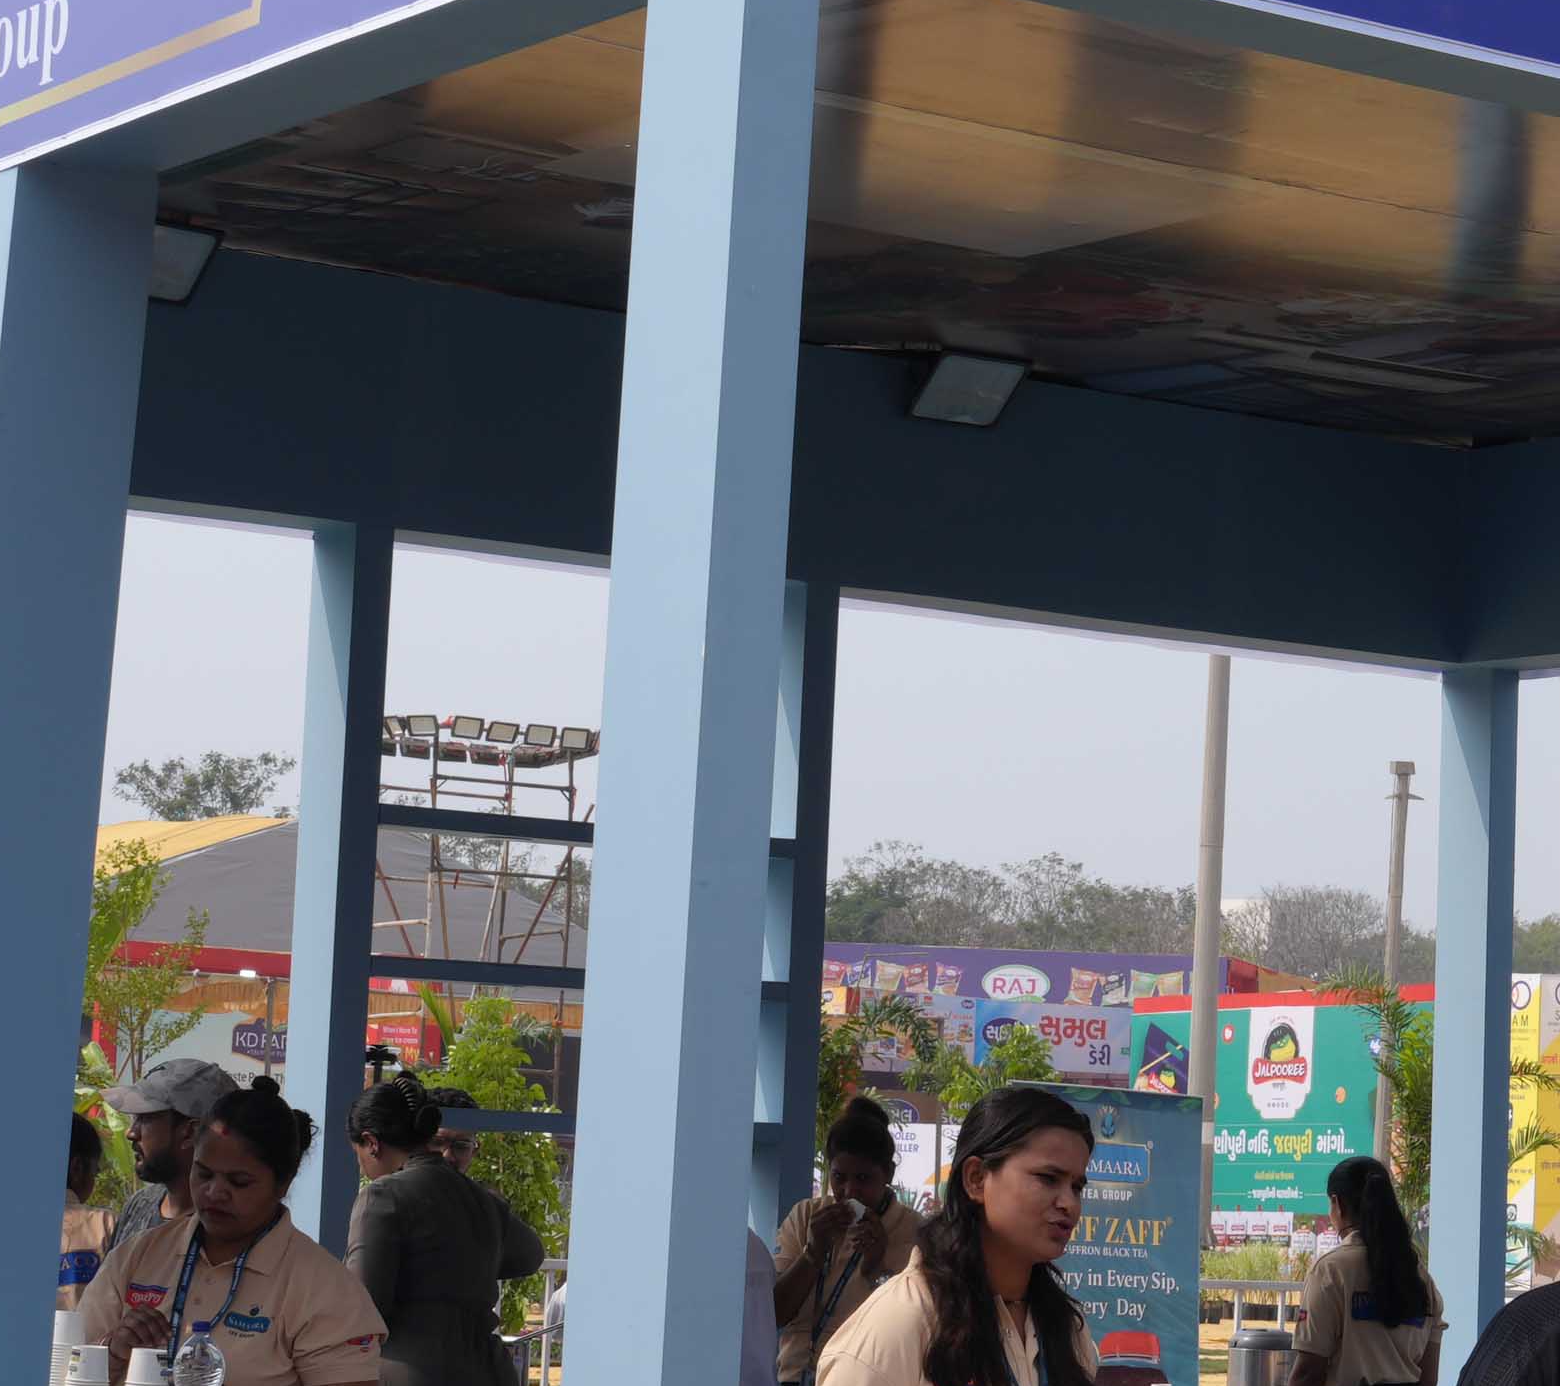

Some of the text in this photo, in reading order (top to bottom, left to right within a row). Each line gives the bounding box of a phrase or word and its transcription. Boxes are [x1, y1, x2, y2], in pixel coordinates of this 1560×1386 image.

[992, 977, 1037, 995] RAJ
[1040, 1014, 1108, 1046] સુમુલ
[235, 1031, 259, 1048] KD
[1254, 1062, 1305, 1078] JALPOOREE
[1086, 1159, 1142, 1176] MAARA
[1102, 1189, 1133, 1201] GROUP
[1105, 1217, 1168, 1246] ZAFF
[1102, 1246, 1148, 1259] BLACK TEA
[1088, 1269, 1180, 1293] in Every Sip,
[1117, 1298, 1146, 1321] Day
